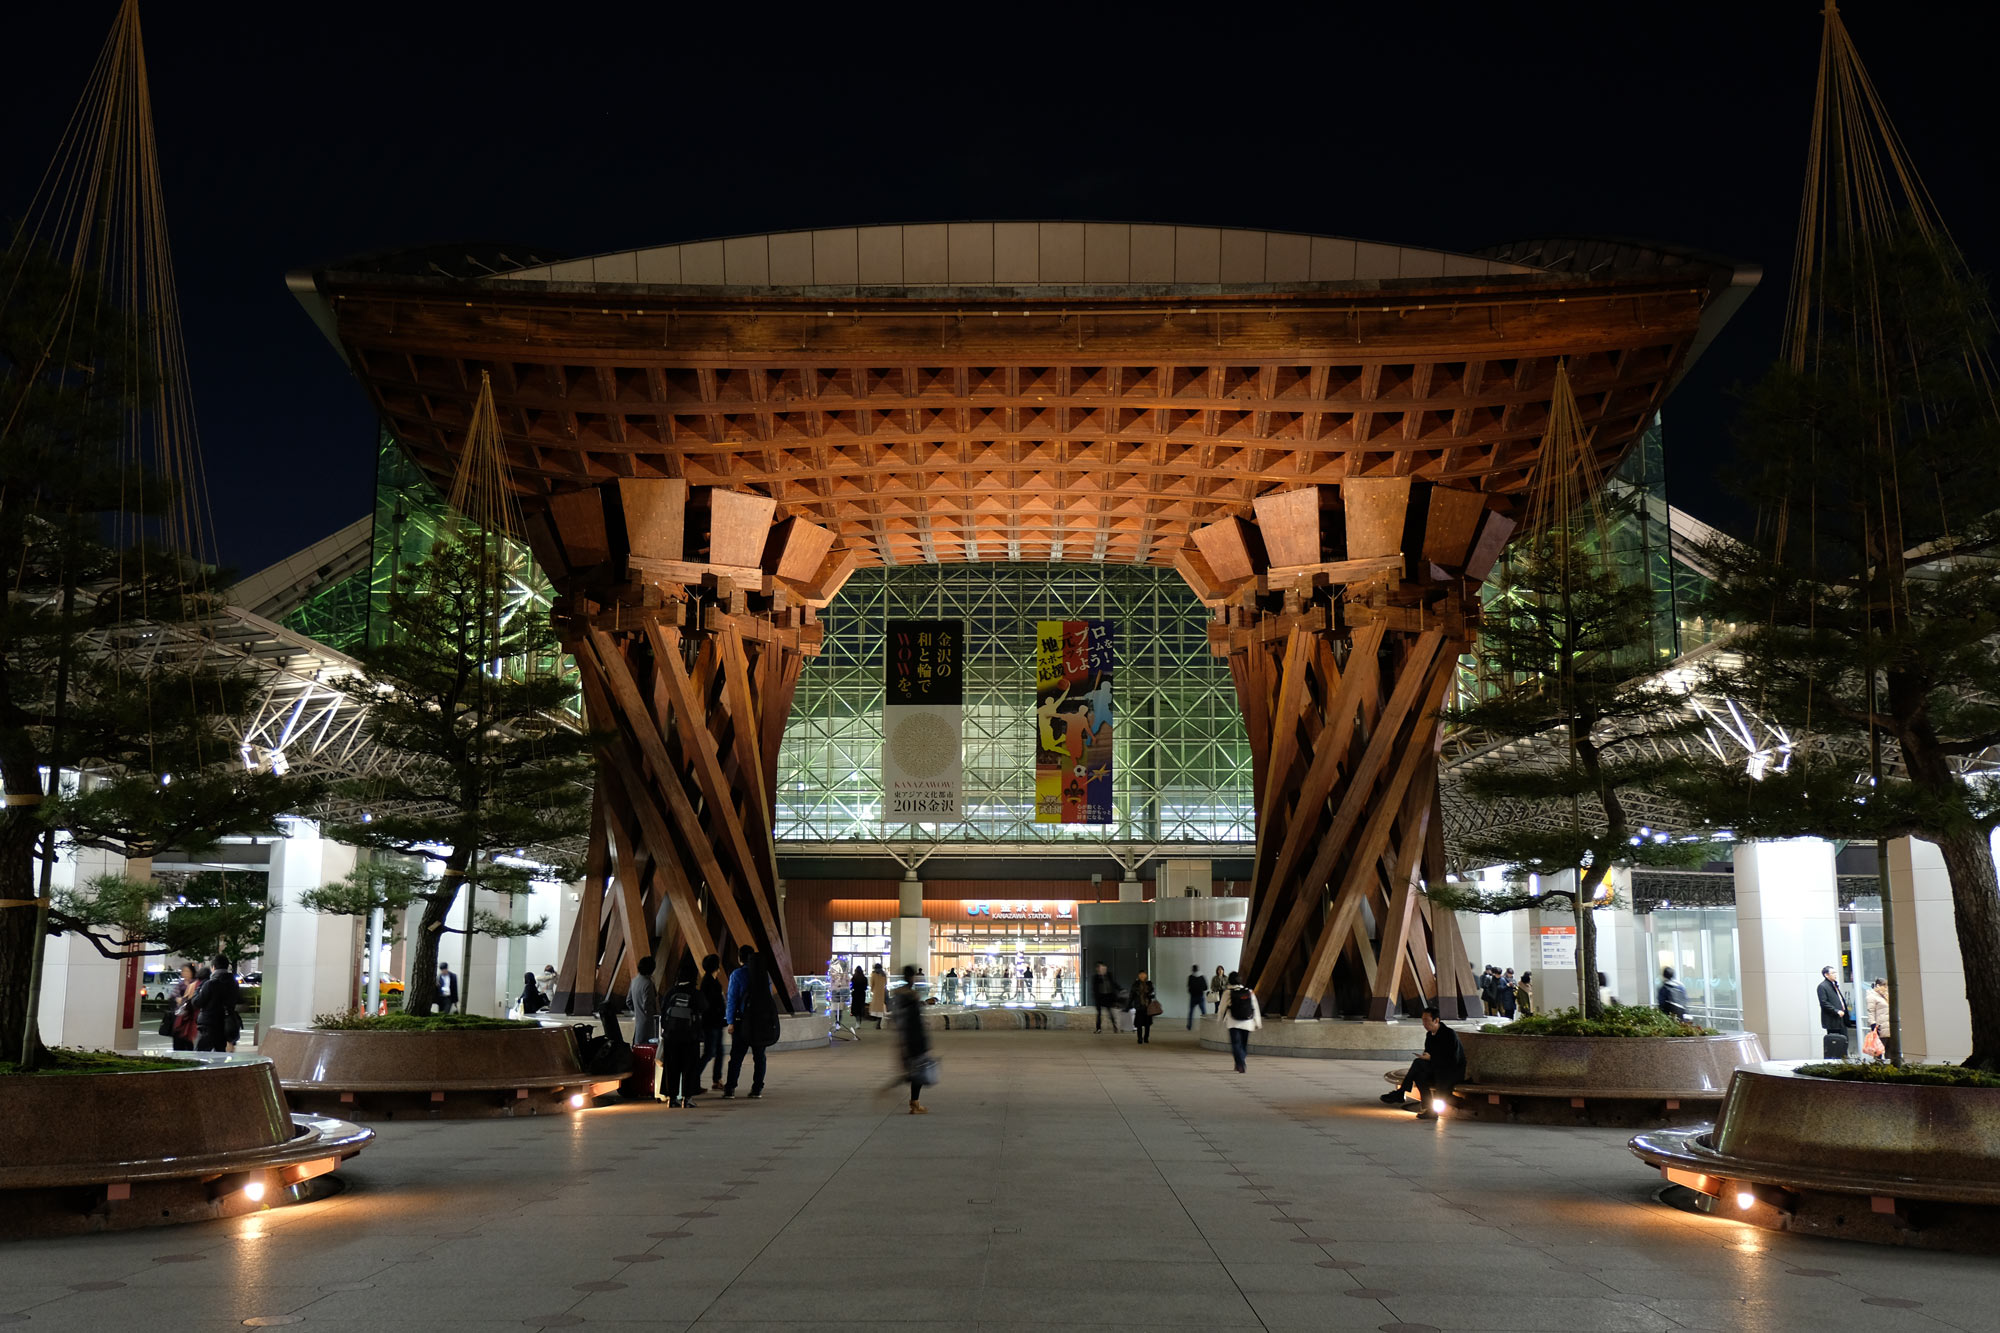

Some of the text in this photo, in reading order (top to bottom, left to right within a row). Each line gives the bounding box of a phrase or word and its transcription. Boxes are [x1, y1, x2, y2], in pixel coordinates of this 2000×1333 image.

[1042, 626, 1106, 654] 地元プロ
[917, 632, 932, 693] 和と輪で
[937, 632, 952, 677] 金沢の
[894, 799, 954, 812] 2018金沢
[967, 904, 990, 915] JR
